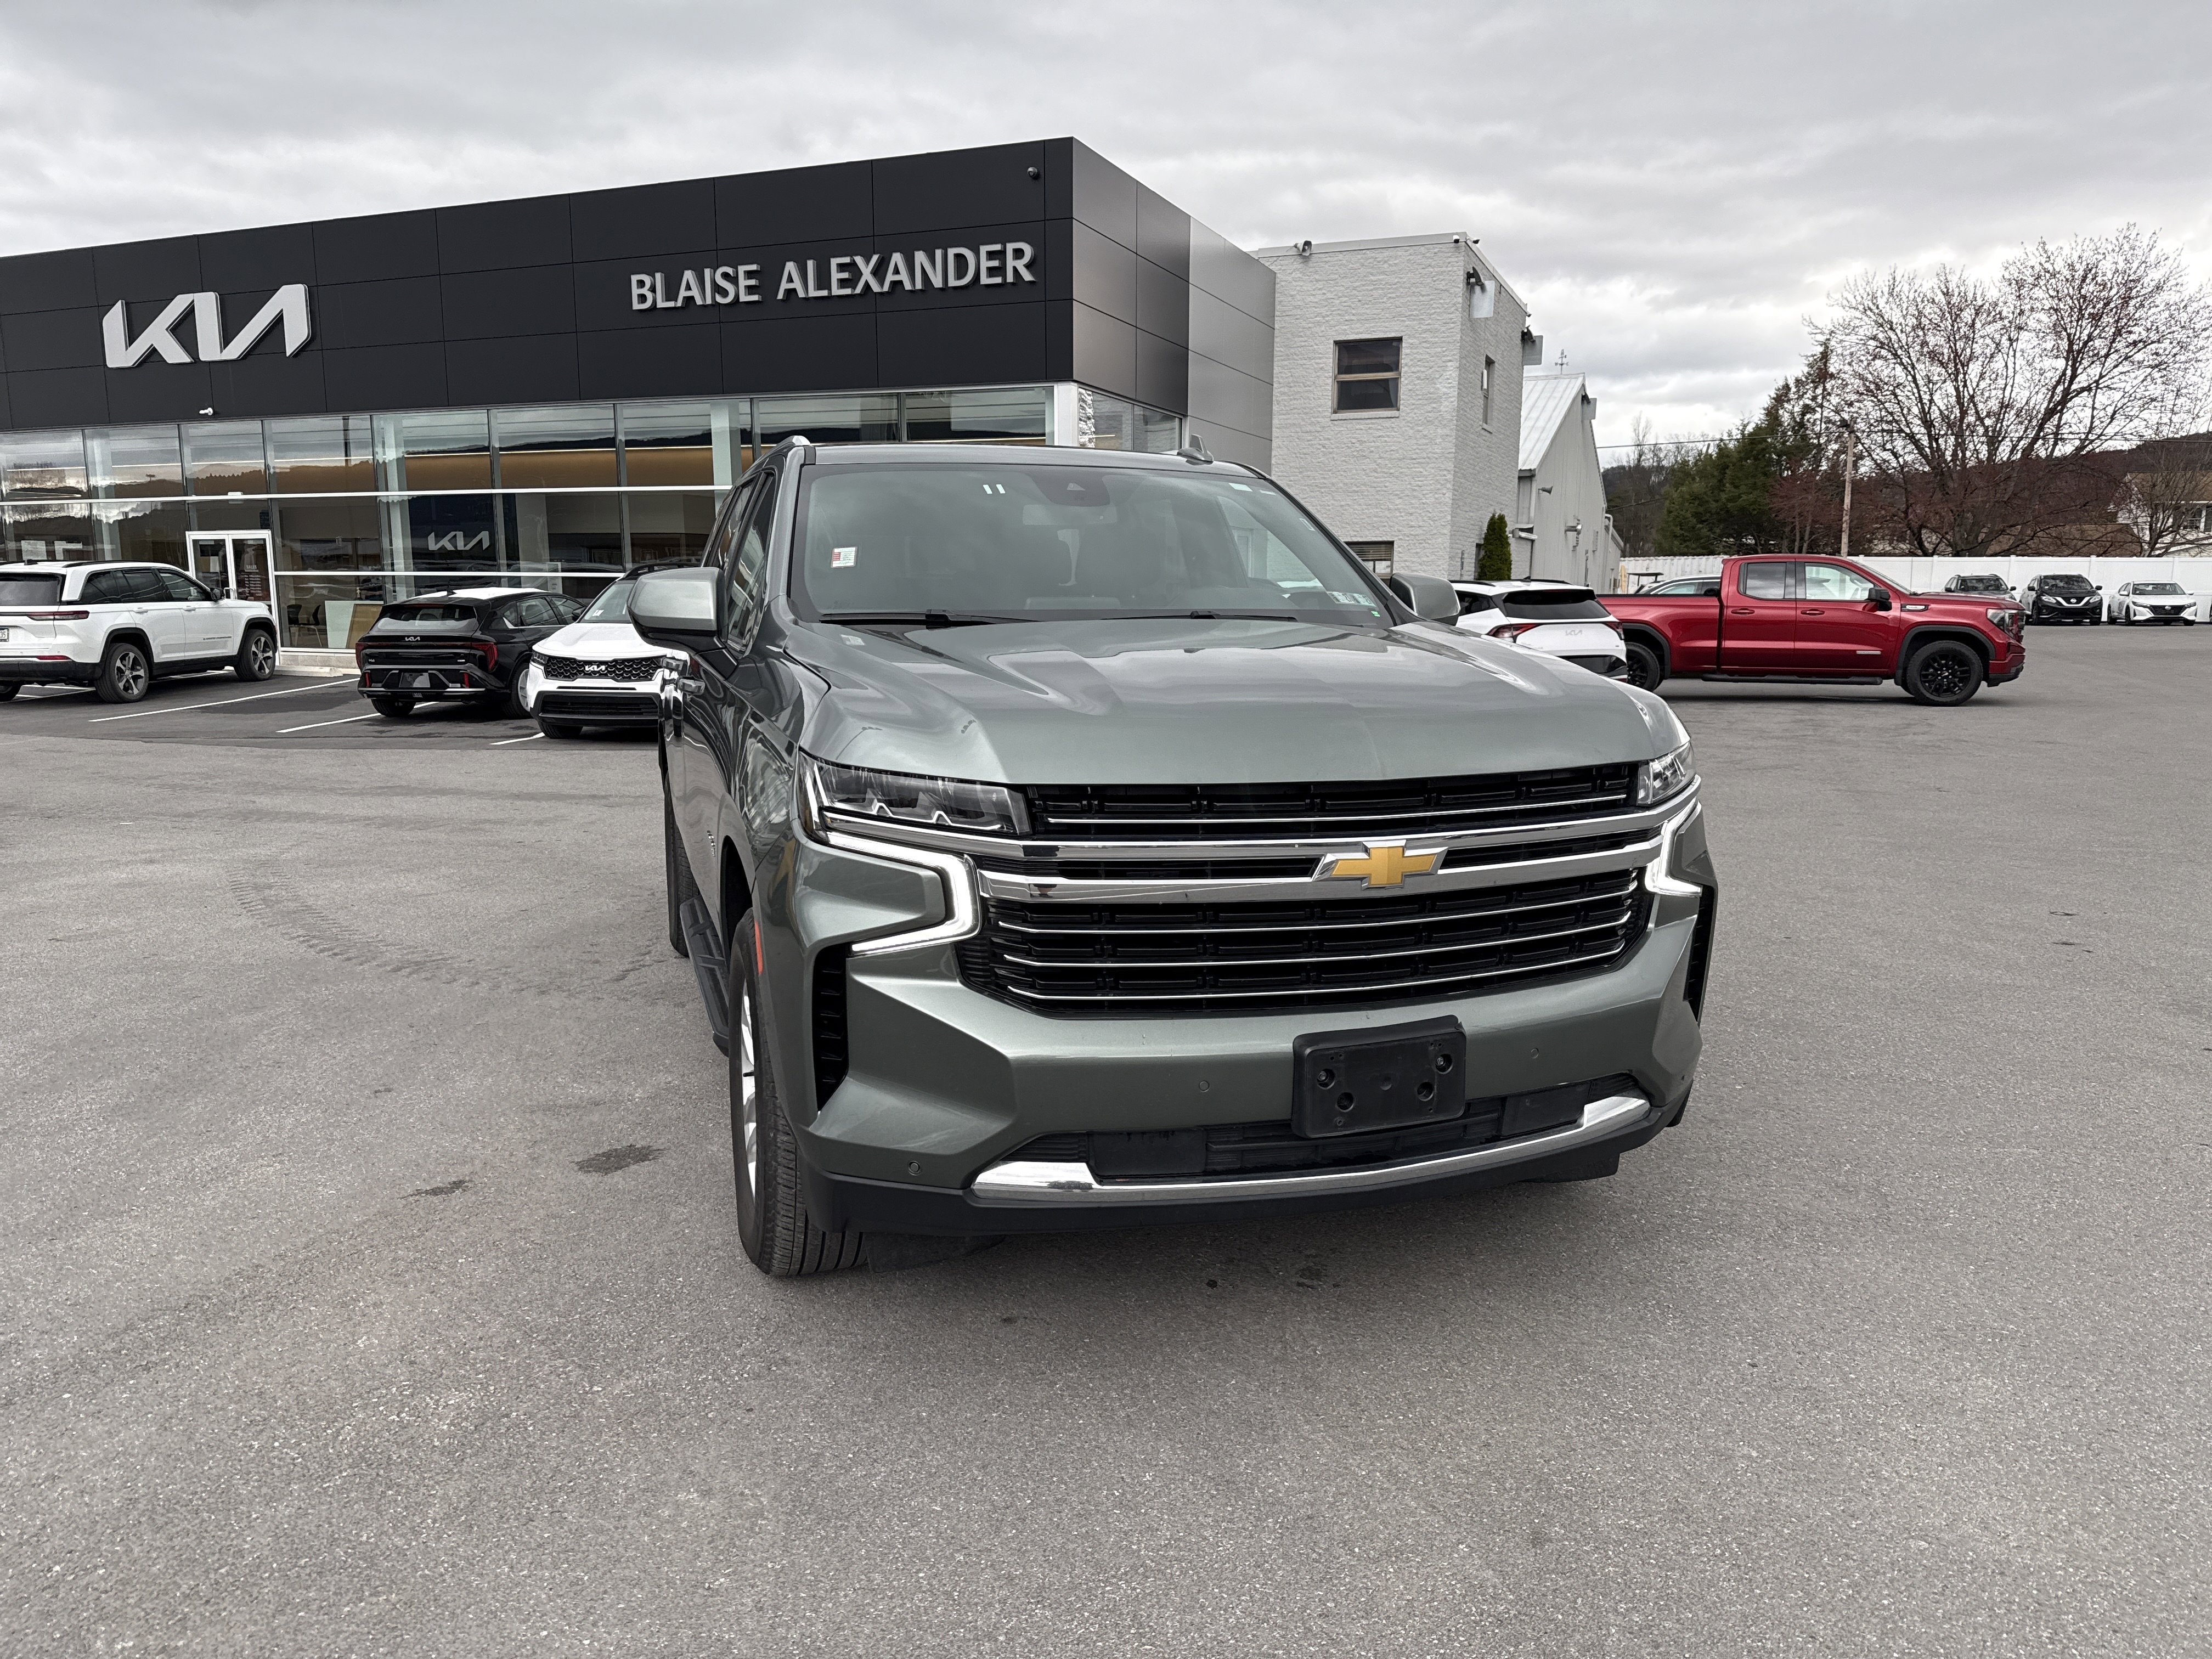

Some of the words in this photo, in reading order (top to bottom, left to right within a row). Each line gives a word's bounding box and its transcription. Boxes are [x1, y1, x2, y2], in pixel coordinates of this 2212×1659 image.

[631, 264, 762, 311] BLAISE
[776, 241, 1036, 300] ALEXANDER
[103, 283, 311, 369] KIA
[428, 531, 489, 550] KIA
